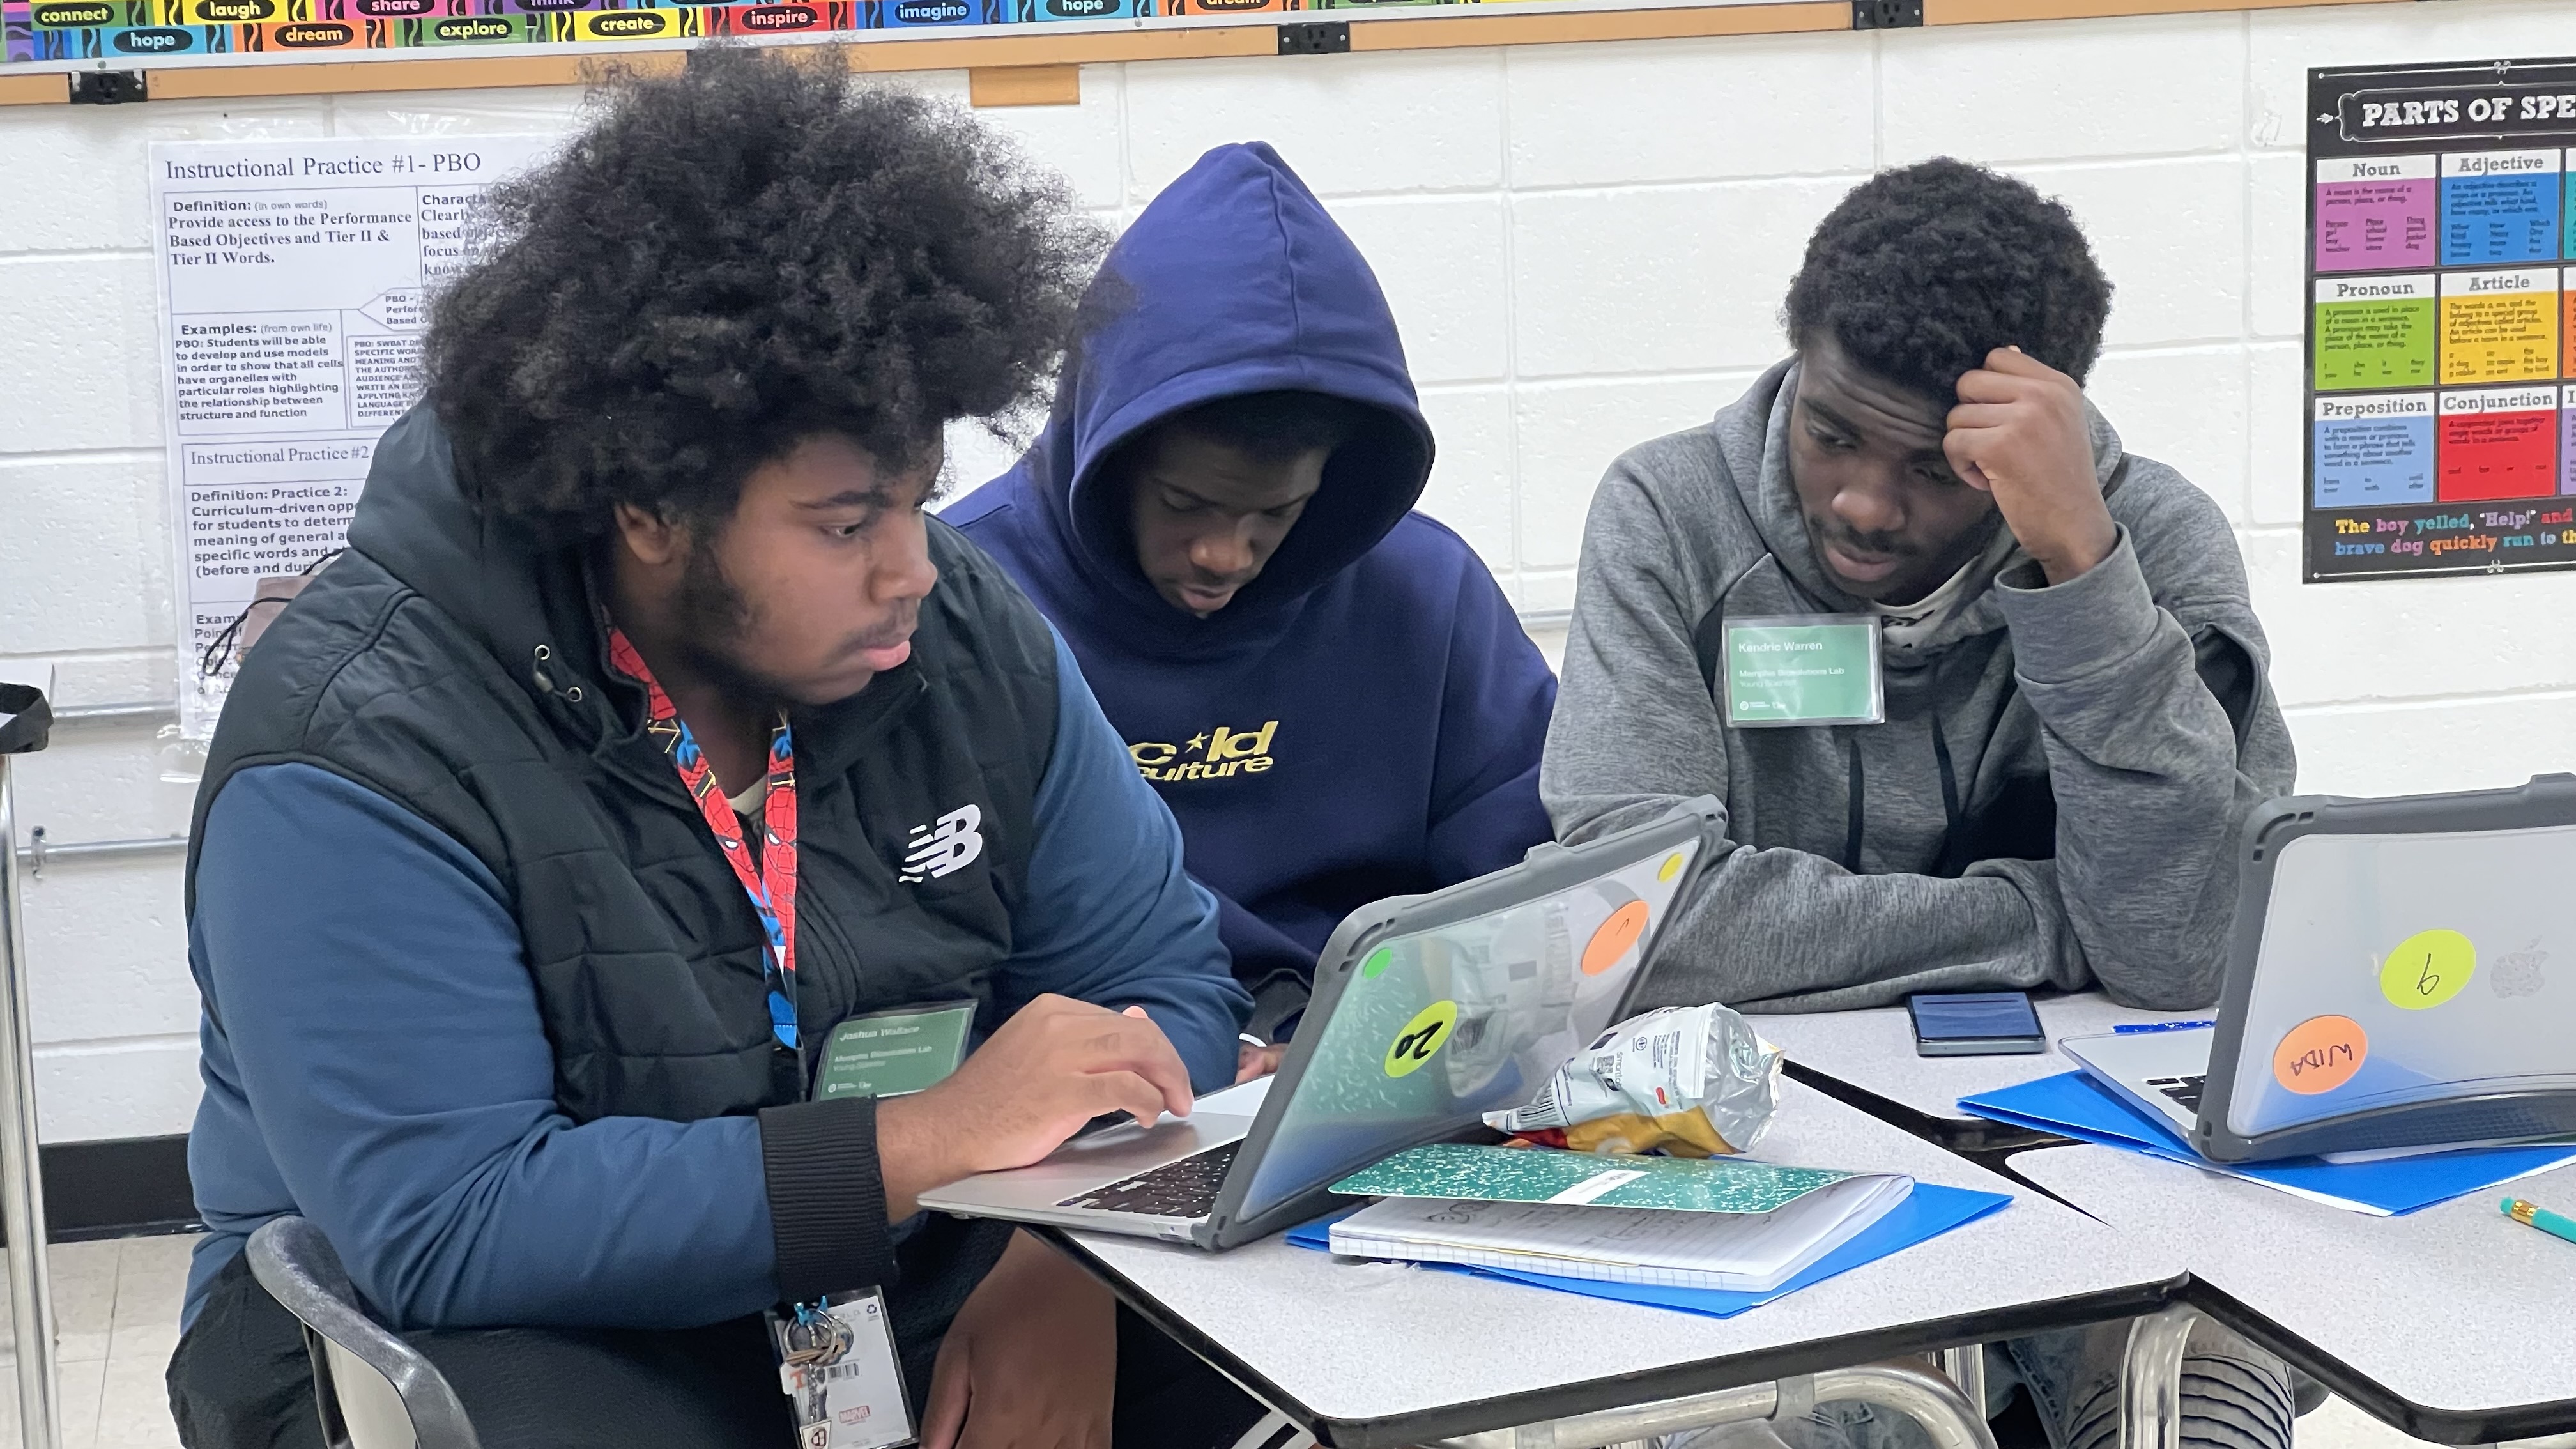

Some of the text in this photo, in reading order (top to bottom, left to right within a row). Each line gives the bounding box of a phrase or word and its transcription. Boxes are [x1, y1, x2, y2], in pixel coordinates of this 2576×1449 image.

[40, 6, 108, 22] connect
[210, 1, 261, 19] laugh
[371, 0, 420, 12] share
[899, 3, 967, 21] imagine
[1062, 0, 1104, 13] hope
[599, 16, 654, 32] create
[751, 8, 808, 30] inspire
[285, 27, 344, 42] dream
[439, 20, 508, 39] explore
[130, 33, 176, 50] hope
[2362, 94, 2576, 127] PARTS OF SPE
[165, 157, 295, 180] Instructional
[302, 155, 383, 176] Practice
[433, 152, 481, 172] PBO
[2352, 162, 2402, 178] Noun
[2458, 155, 2544, 177] Adjective
[173, 199, 328, 212] Definition: (in own words)
[168, 211, 412, 229] Provide access to the Performance
[169, 234, 212, 248] Based
[215, 233, 291, 249] Objectives
[294, 231, 321, 245] and
[325, 230, 356, 244] Tier
[376, 229, 391, 242] &
[422, 226, 461, 240] based
[170, 252, 202, 266] Tier
[222, 250, 275, 265] Words.
[423, 245, 459, 257] focus
[2336, 283, 2415, 298] Pronoun
[2469, 275, 2531, 291] Article
[385, 295, 406, 303] PBO
[386, 316, 417, 325] Based
[181, 322, 333, 337] Examples: (from own life)
[175, 335, 327, 349] PBO: Students will be able
[176, 347, 330, 362] to develop and use models
[355, 348, 395, 356] SPECIFIC
[176, 359, 344, 372] in order to show that all cells
[177, 372, 298, 386] have organelles with
[178, 383, 339, 398] particular roles highlighting
[178, 395, 324, 409] the relationship between
[2322, 399, 2427, 420] Preposition
[2443, 392, 2554, 414] Conjunction
[180, 408, 307, 421] structure and function
[191, 445, 370, 465] Instructional Practice #2
[191, 486, 348, 502] Definition: Practice 2:
[191, 503, 325, 518] Curriculum-driven
[192, 520, 214, 532] for
[217, 518, 282, 531] students
[284, 518, 300, 528] to
[2335, 519, 2371, 535] The
[2375, 518, 2409, 537] boy
[2414, 513, 2476, 535] yelled,
[2541, 507, 2573, 524] and
[194, 535, 258, 547] meaning
[260, 533, 276, 544] of
[279, 530, 334, 546] general
[2334, 542, 2386, 556] brave
[2391, 539, 2424, 556] dog
[2429, 534, 2498, 556] quickly
[2503, 535, 2534, 548] run
[2540, 531, 2557, 546] to
[194, 546, 328, 564] specific words and
[195, 565, 250, 579] (before
[253, 562, 280, 574] and
[195, 614, 239, 625] Exam
[1738, 641, 1823, 653] Kendric Warren
[1828, 666, 1845, 676] Lab
[839, 1029, 878, 1042] Joshua
[2289, 1043, 2354, 1077] WIDA
